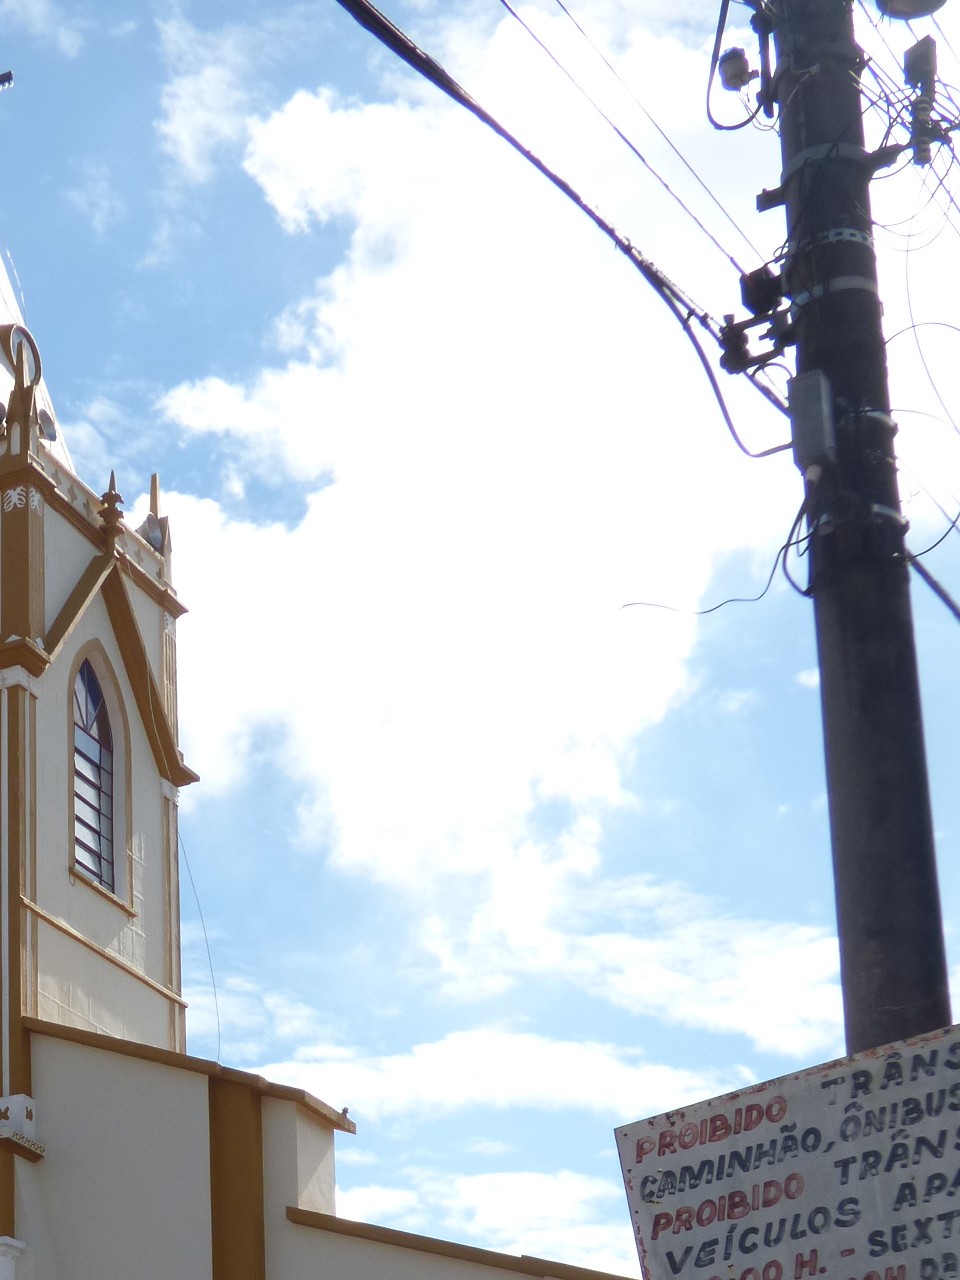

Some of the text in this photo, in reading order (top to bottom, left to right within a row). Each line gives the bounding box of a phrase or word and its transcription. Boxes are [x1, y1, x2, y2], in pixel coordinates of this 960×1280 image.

[635, 1095, 787, 1163] PROIBIDO
[640, 1121, 836, 1202] CAMINHÃO,
[651, 1172, 805, 1240] PROIBIDO
[665, 1197, 862, 1275] VEÍCULOS
